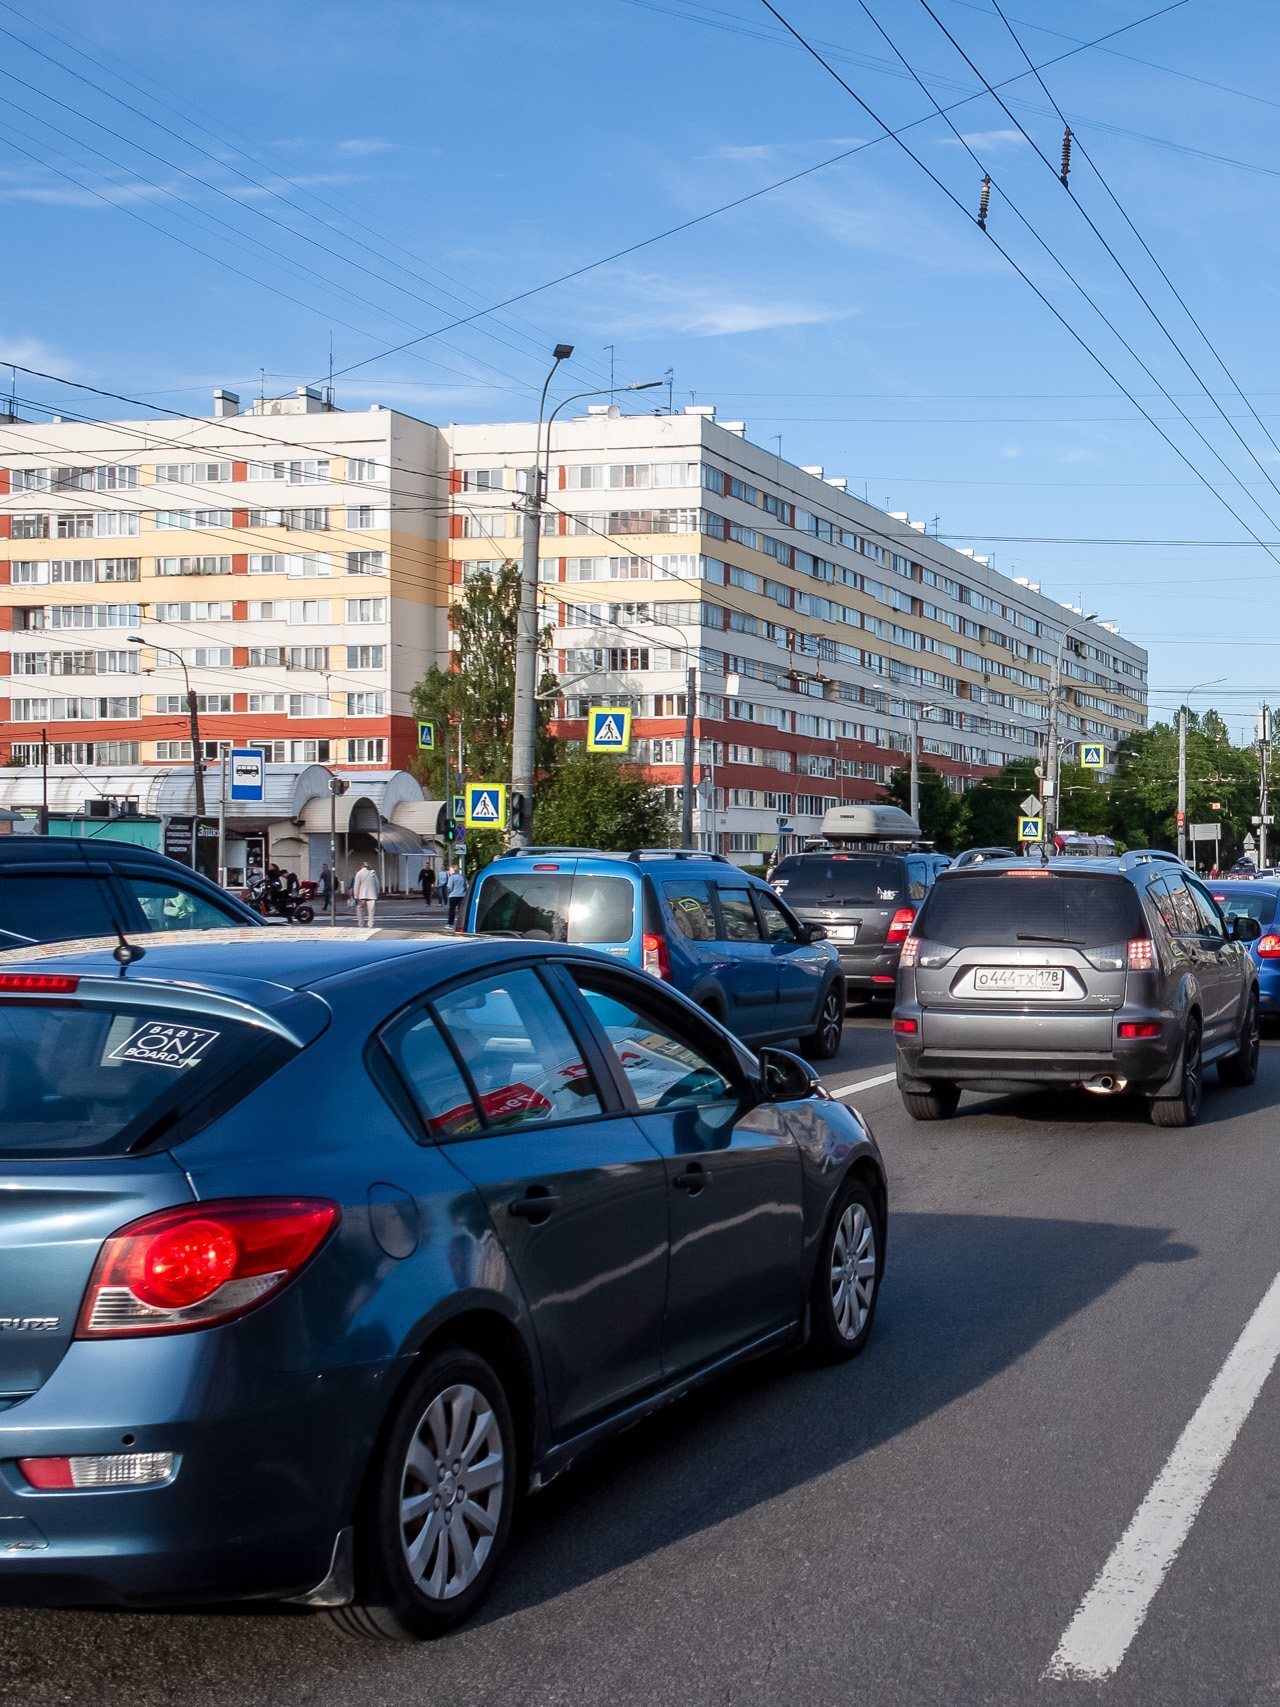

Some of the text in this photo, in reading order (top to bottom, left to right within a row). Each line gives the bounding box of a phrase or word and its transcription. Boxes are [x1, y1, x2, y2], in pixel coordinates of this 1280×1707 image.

[149, 1026, 205, 1040] BABY
[137, 1035, 197, 1054] ON
[124, 1047, 179, 1061] BOARD
